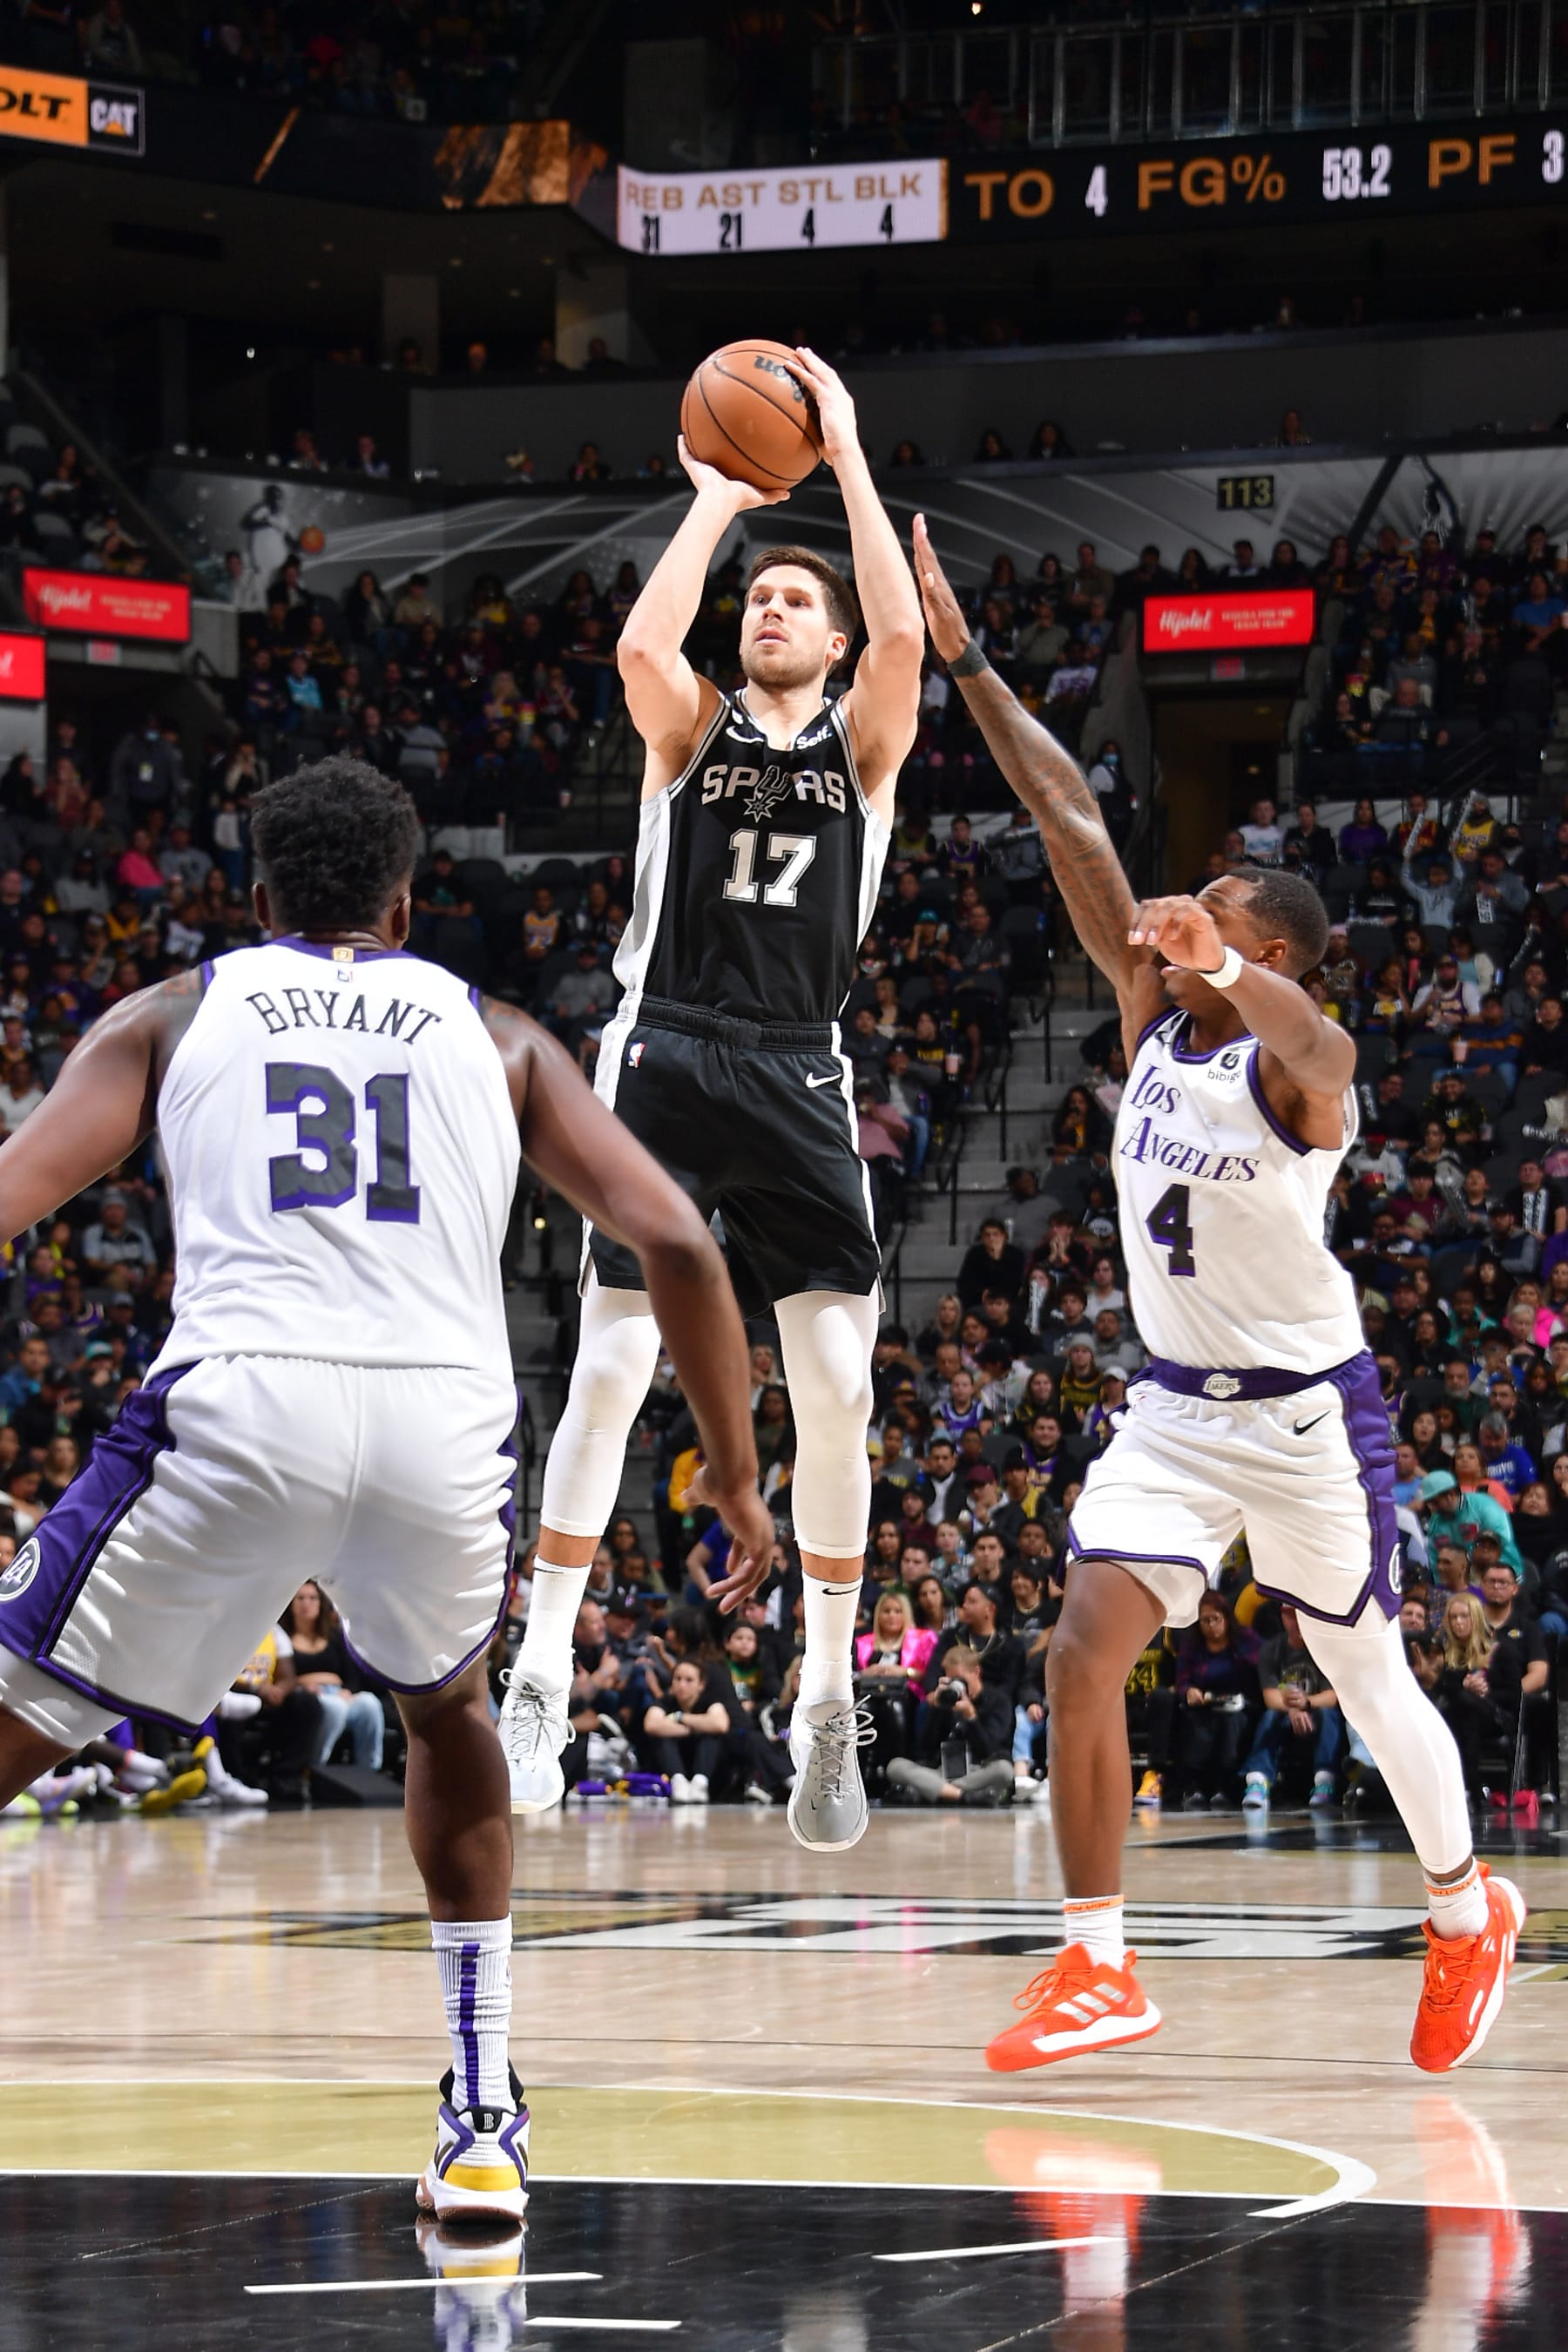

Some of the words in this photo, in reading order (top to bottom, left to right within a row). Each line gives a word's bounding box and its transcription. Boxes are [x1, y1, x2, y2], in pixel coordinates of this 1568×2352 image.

[90, 98, 137, 137] CAT
[625, 180, 684, 210] REB
[698, 181, 767, 208] AST
[778, 178, 843, 205] STL
[854, 173, 922, 201] BLK
[964, 169, 1055, 221] TO
[1085, 164, 1108, 217] 4
[1137, 154, 1286, 211] FG%
[1322, 144, 1392, 201] 53.2
[1428, 133, 1517, 189] PF
[1541, 130, 1565, 184] 3
[641, 214, 660, 253] 31
[720, 212, 742, 252] 21
[801, 206, 815, 247] 4
[879, 202, 895, 243] 4
[1220, 479, 1270, 508] 113
[701, 765, 846, 814] SPURS
[721, 828, 817, 907] 17
[245, 987, 443, 1045] BRYANT
[1207, 1068, 1241, 1084] bibigo
[265, 1062, 421, 1224] 31
[1145, 1183, 1195, 1278] 4
